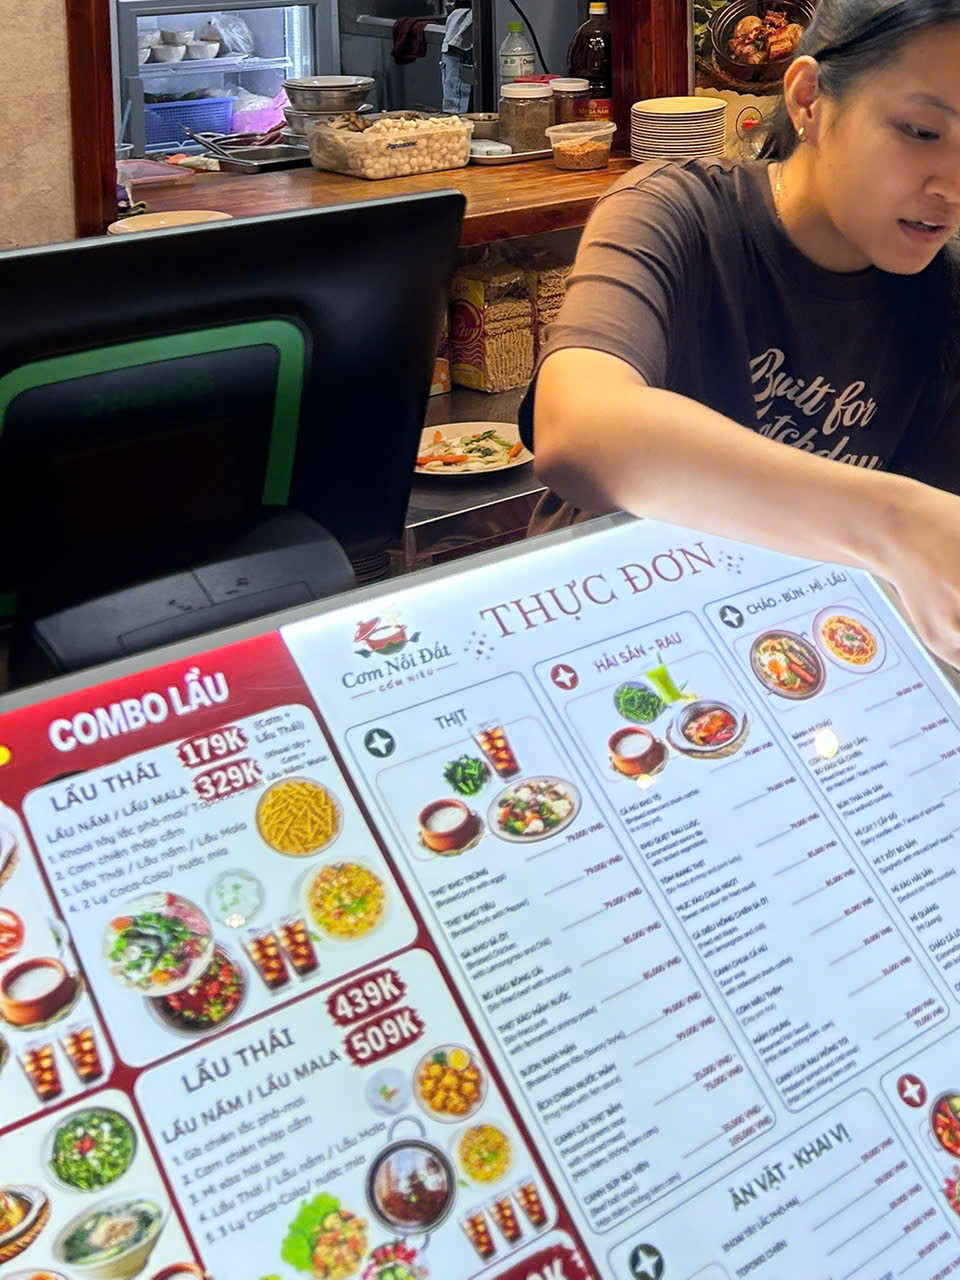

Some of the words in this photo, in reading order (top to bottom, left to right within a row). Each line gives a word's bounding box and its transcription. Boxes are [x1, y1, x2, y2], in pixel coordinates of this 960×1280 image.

[749, 347, 836, 417] Built
[822, 380, 880, 436] for
[479, 572, 619, 639] THỰC
[618, 540, 717, 595] ĐƠN
[746, 594, 776, 616] CHÁO
[783, 584, 806, 604] BÚN
[341, 666, 385, 690] Cơm
[384, 654, 417, 678] Nồi
[419, 642, 453, 668] Đất
[657, 631, 682, 654] RAU
[49, 692, 168, 752] COMBO
[434, 707, 468, 731] THỊT
[182, 728, 247, 765] 179K
[104, 761, 161, 798] THÁI
[196, 761, 262, 799] 329K
[335, 972, 400, 1020] 439K
[351, 1009, 421, 1060] 509K
[728, 1183, 758, 1212] ĂN
[754, 1161, 787, 1193] VẶT
[793, 1132, 834, 1170] KHAI
[829, 1122, 852, 1143] VỊ
